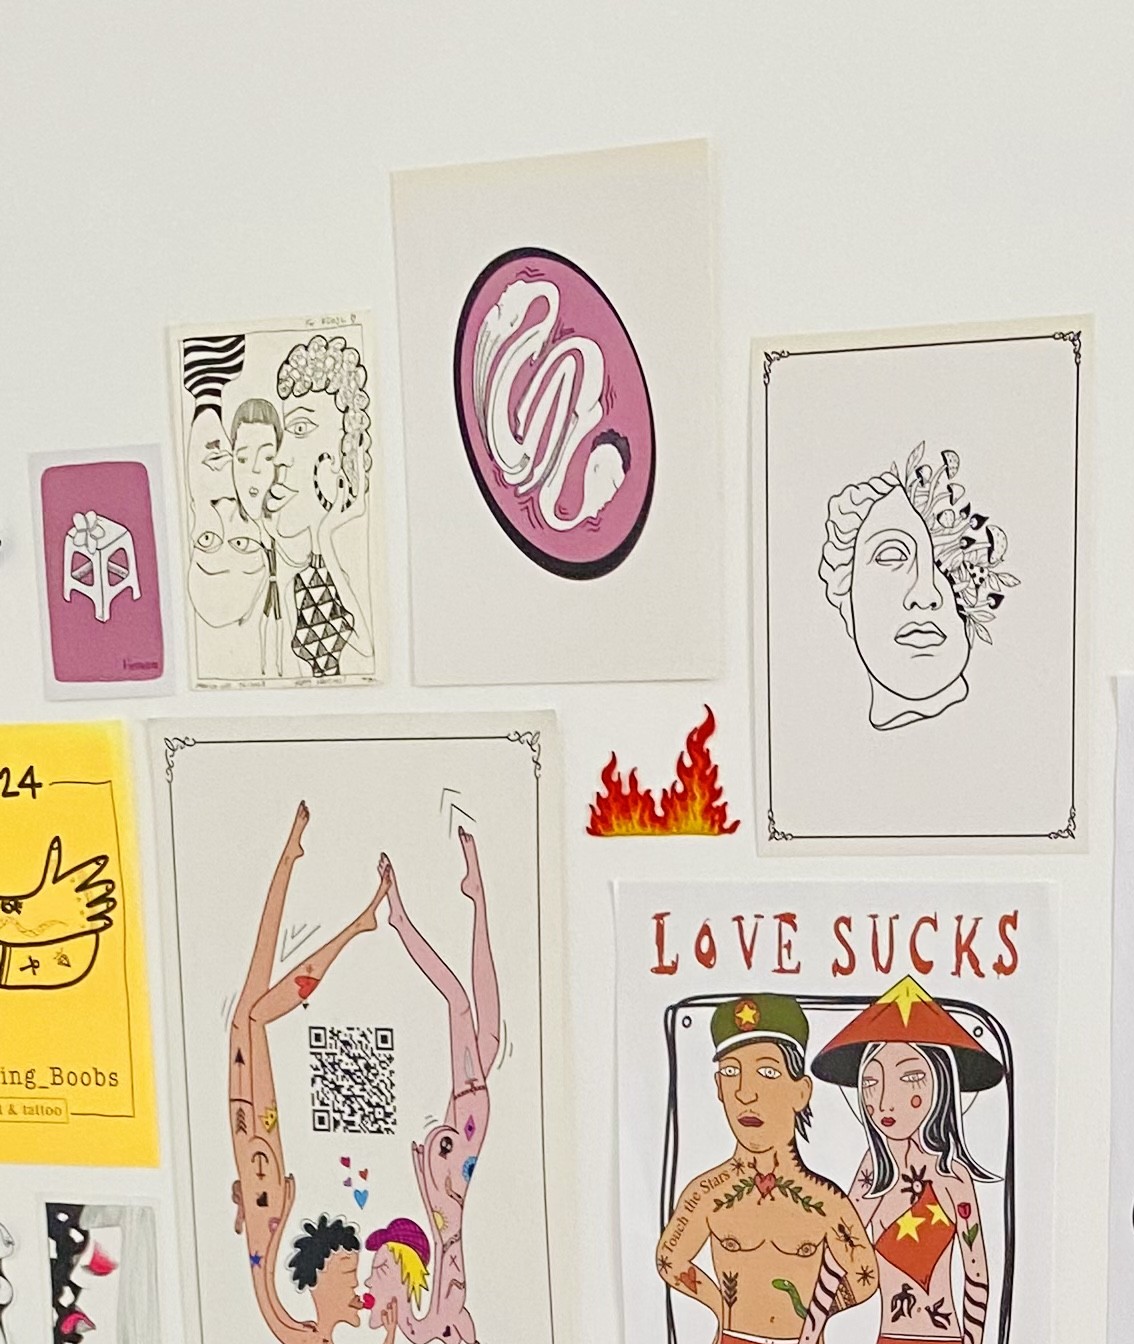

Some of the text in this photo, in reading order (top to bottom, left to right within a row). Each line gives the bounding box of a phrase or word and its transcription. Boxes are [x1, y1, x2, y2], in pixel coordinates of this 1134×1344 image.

[650, 910, 1020, 979] LOVE SUCKS
[662, 1170, 731, 1253] Touch the Stars
